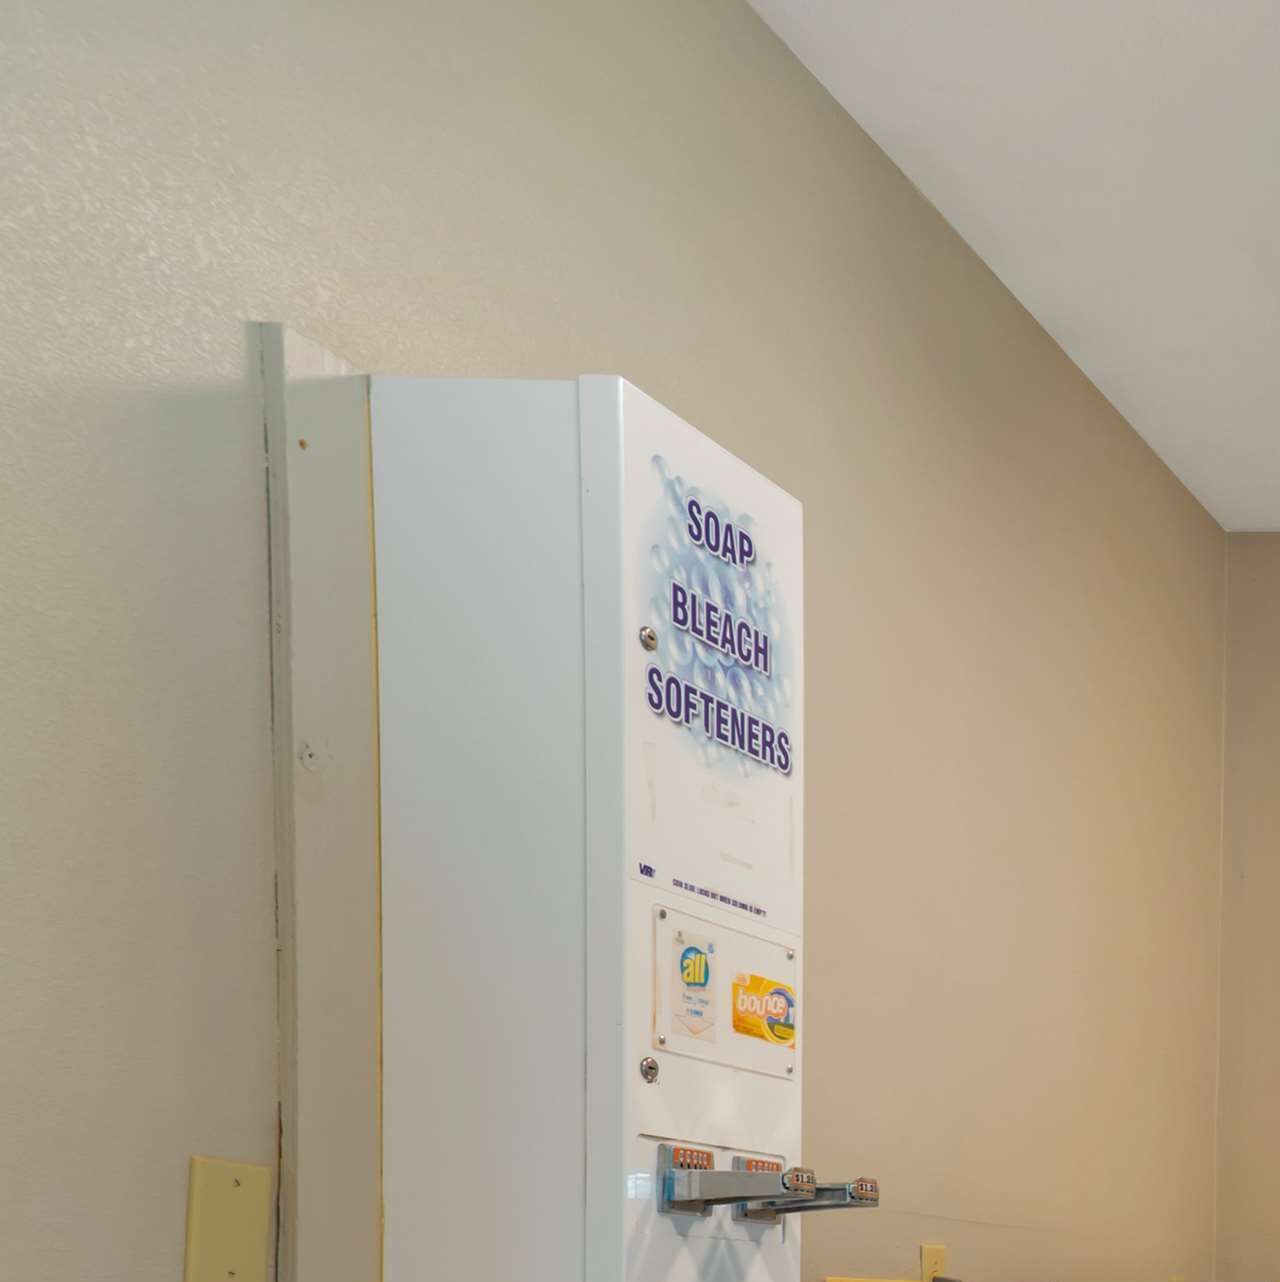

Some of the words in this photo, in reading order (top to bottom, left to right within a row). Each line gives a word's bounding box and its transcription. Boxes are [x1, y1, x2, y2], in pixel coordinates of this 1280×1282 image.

[686, 498, 754, 566] SOAP
[671, 580, 770, 674] BLEACH
[646, 665, 791, 773] SOFTENERS
[682, 953, 707, 984] all
